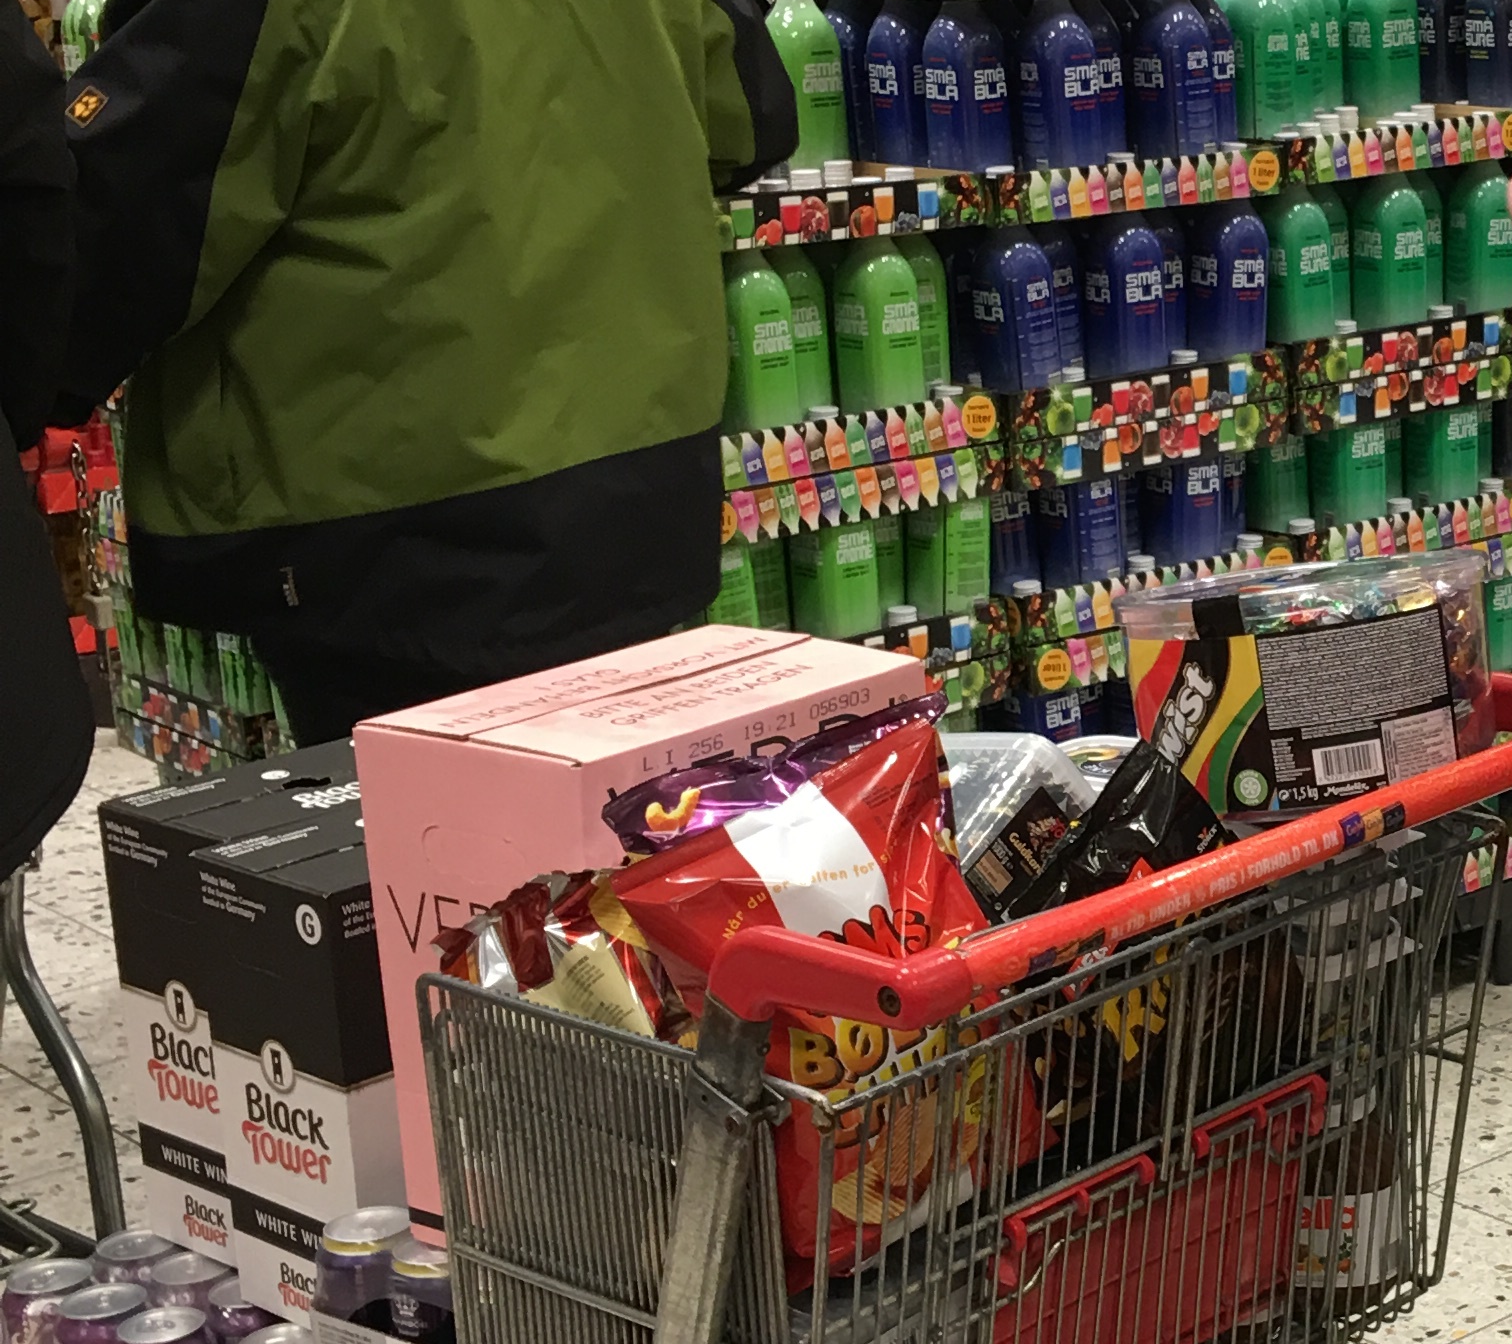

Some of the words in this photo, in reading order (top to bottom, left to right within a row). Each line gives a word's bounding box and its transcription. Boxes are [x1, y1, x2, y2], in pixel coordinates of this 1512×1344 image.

[700, 660, 780, 690] BEIDEN
[719, 664, 812, 697] TRAGEN
[689, 734, 725, 757] 256
[809, 688, 871, 721] 056903
[1209, 874, 1237, 900] PRIS
[721, 910, 745, 941] Når
[245, 1082, 330, 1150] Black
[161, 1145, 200, 1174] WHITE
[241, 1120, 332, 1184] Tower
[184, 1194, 226, 1230] Black
[255, 1210, 296, 1242] WHITE
[184, 1214, 228, 1247] Tower
